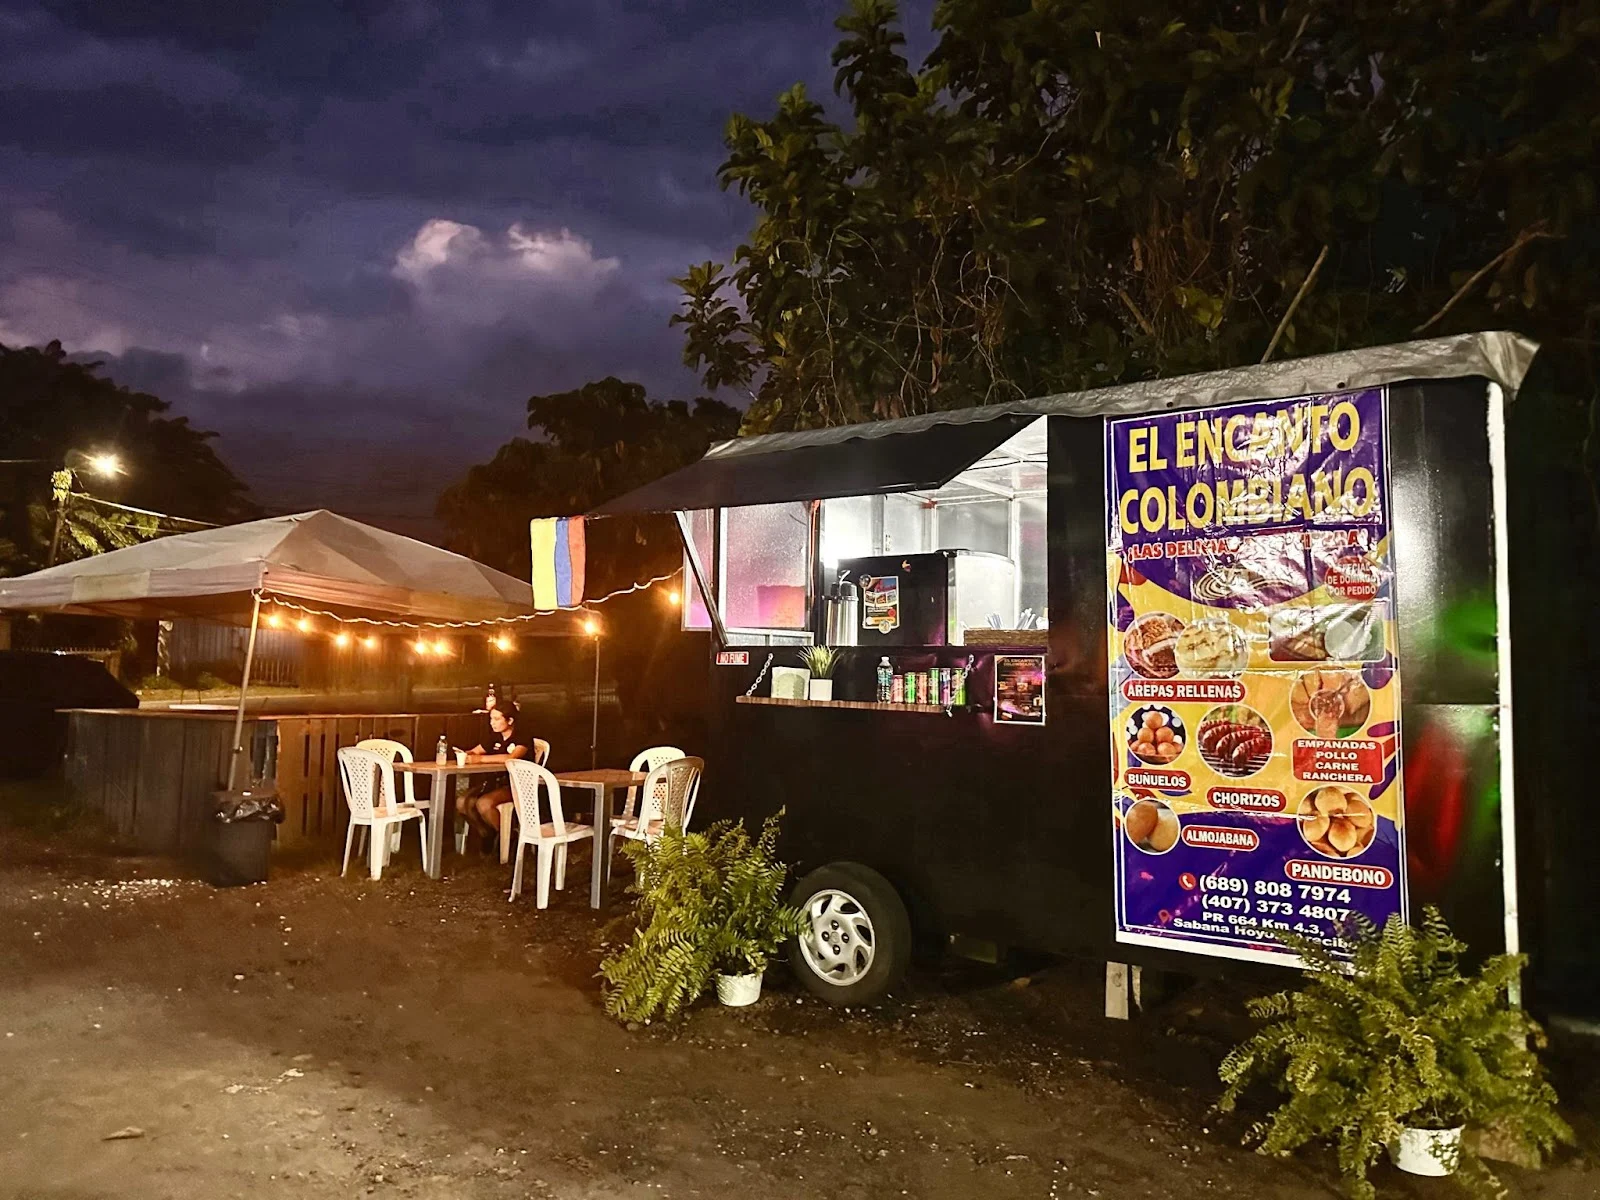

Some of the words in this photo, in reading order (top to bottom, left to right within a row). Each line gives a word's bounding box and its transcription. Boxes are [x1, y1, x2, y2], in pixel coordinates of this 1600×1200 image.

[1128, 426, 1168, 473] EL
[1176, 401, 1360, 468] ENCANTO
[1120, 467, 1376, 534] COLOMBIANO
[1332, 562, 1371, 574] EPECIAL
[1327, 575, 1338, 585] DE
[1347, 585, 1376, 596] PEDIDO
[1127, 683, 1175, 698] AREPAS
[1176, 684, 1242, 698] RELLENAS
[1297, 739, 1377, 750] EMPANADAS
[1316, 751, 1358, 761] POLLO
[1315, 761, 1359, 771] CARNE
[1127, 772, 1187, 788] BUÑUELOS
[1302, 772, 1374, 783] RANCHERA
[1212, 791, 1280, 808] CHORIZOS
[1186, 829, 1254, 847] ALMOJABANA
[1291, 862, 1386, 884] PANDEBONO
[1199, 874, 1249, 895] (689)
[1254, 881, 1293, 898] 808
[1298, 884, 1352, 904] 7974
[1201, 893, 1251, 914] (407)
[1256, 900, 1294, 916] 373
[1298, 905, 1351, 922] 4807
[1173, 917, 1231, 934] Sabana
[1234, 925, 1279, 941] Hoyo
[1202, 911, 1225, 924] PR
[1228, 914, 1258, 928] 664
[1262, 917, 1290, 931] Km
[1293, 922, 1326, 937] 4.3,
